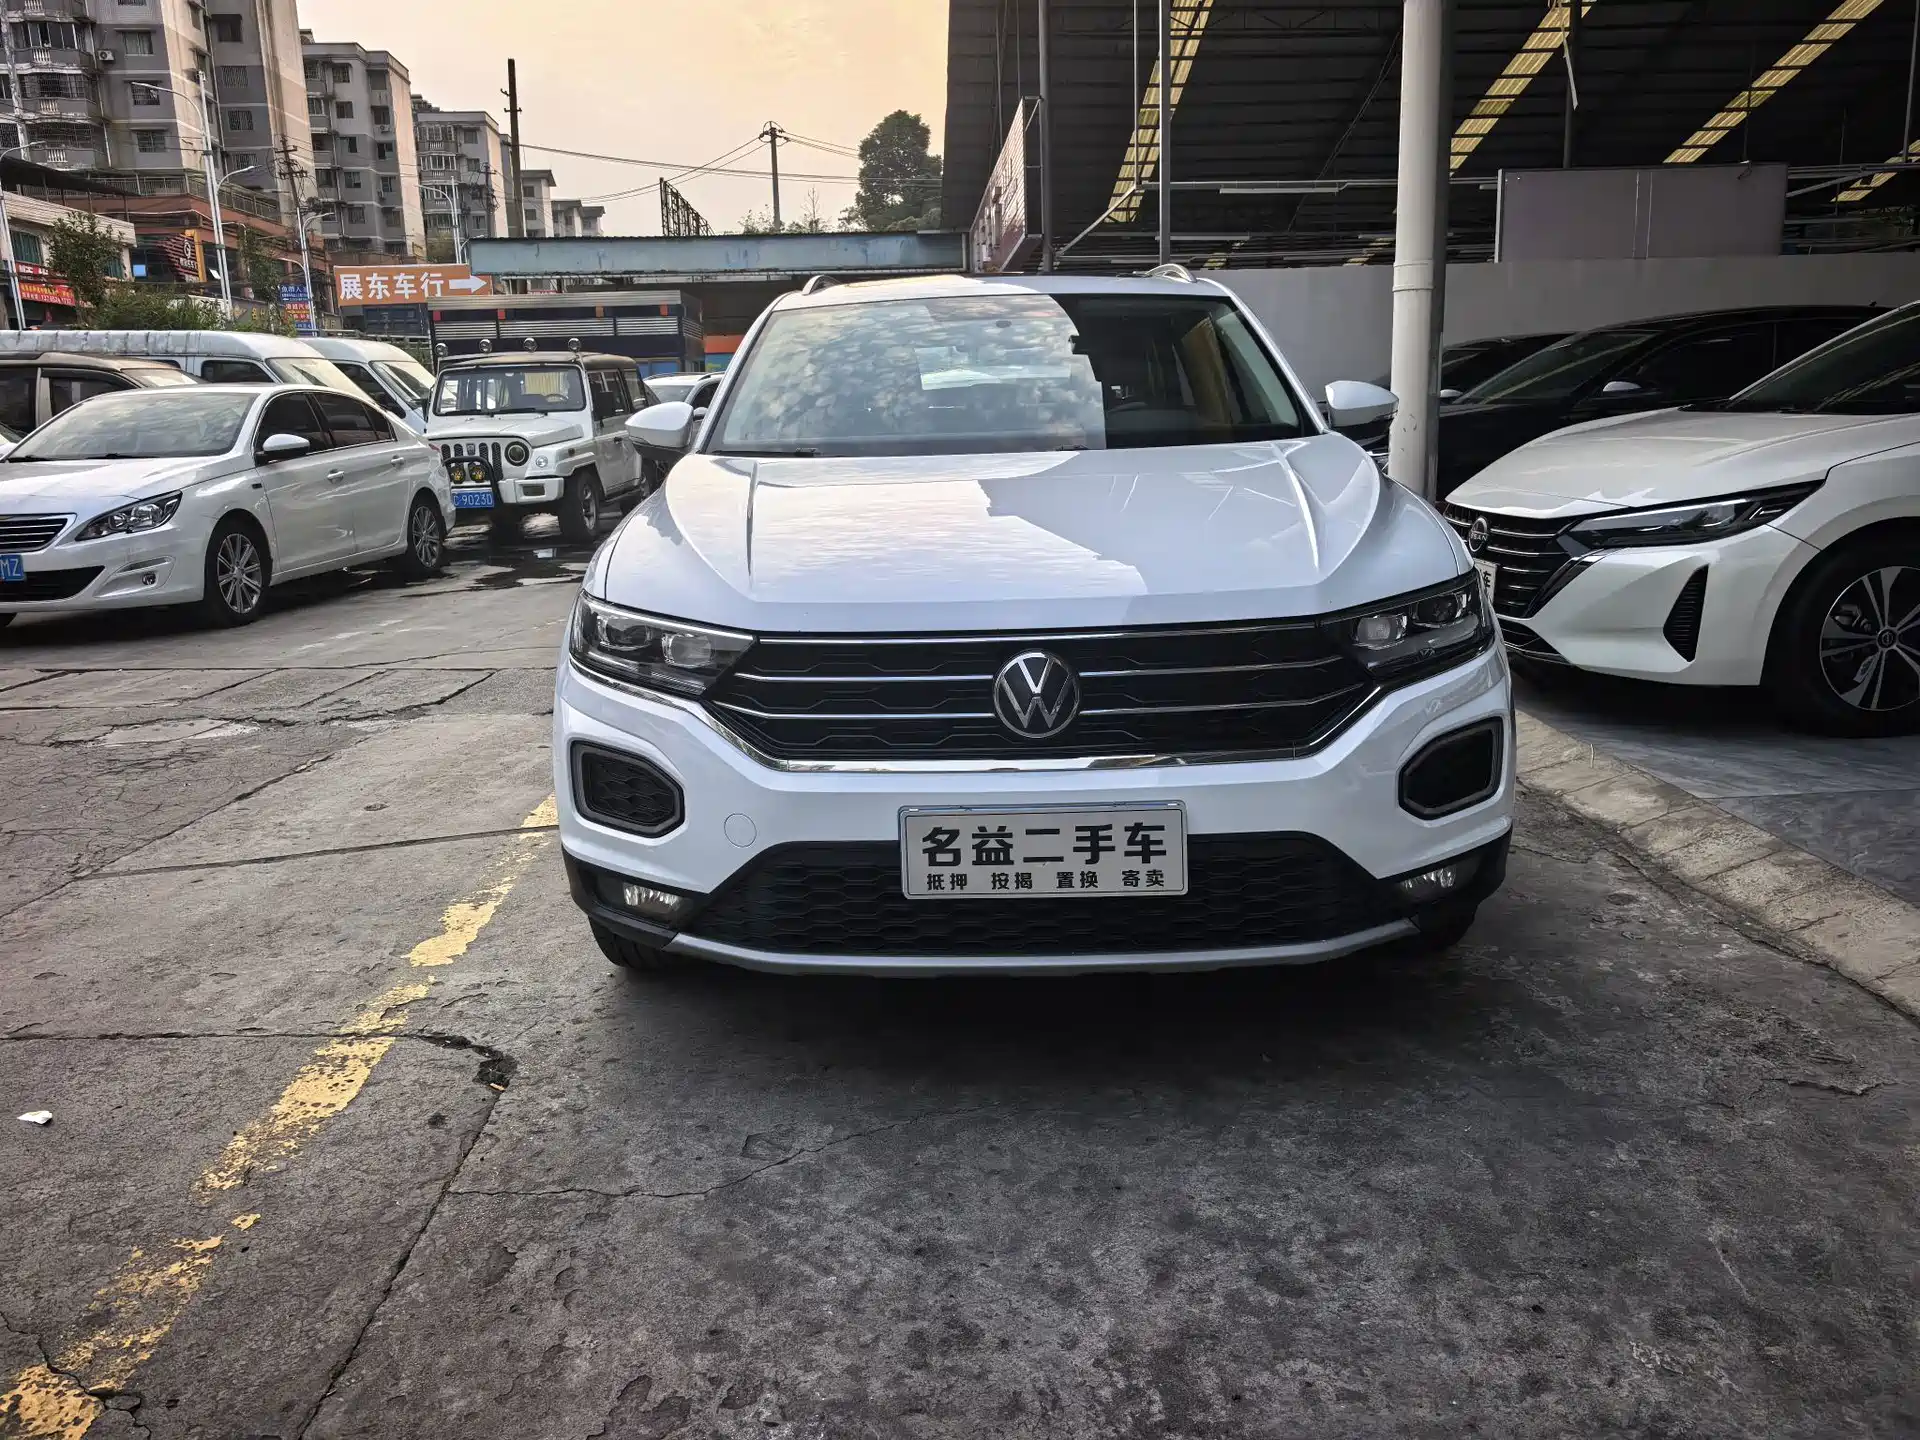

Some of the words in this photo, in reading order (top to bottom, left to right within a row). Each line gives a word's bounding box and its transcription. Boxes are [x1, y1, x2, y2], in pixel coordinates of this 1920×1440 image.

[340, 272, 444, 300] 展东车行
[995, 652, 1079, 736] VW
[922, 822, 1167, 867] 名益二手车
[927, 872, 968, 891] 抵押
[991, 871, 1033, 890] 按揭
[1056, 870, 1099, 889] 置换
[1121, 869, 1165, 888] 寄卖
